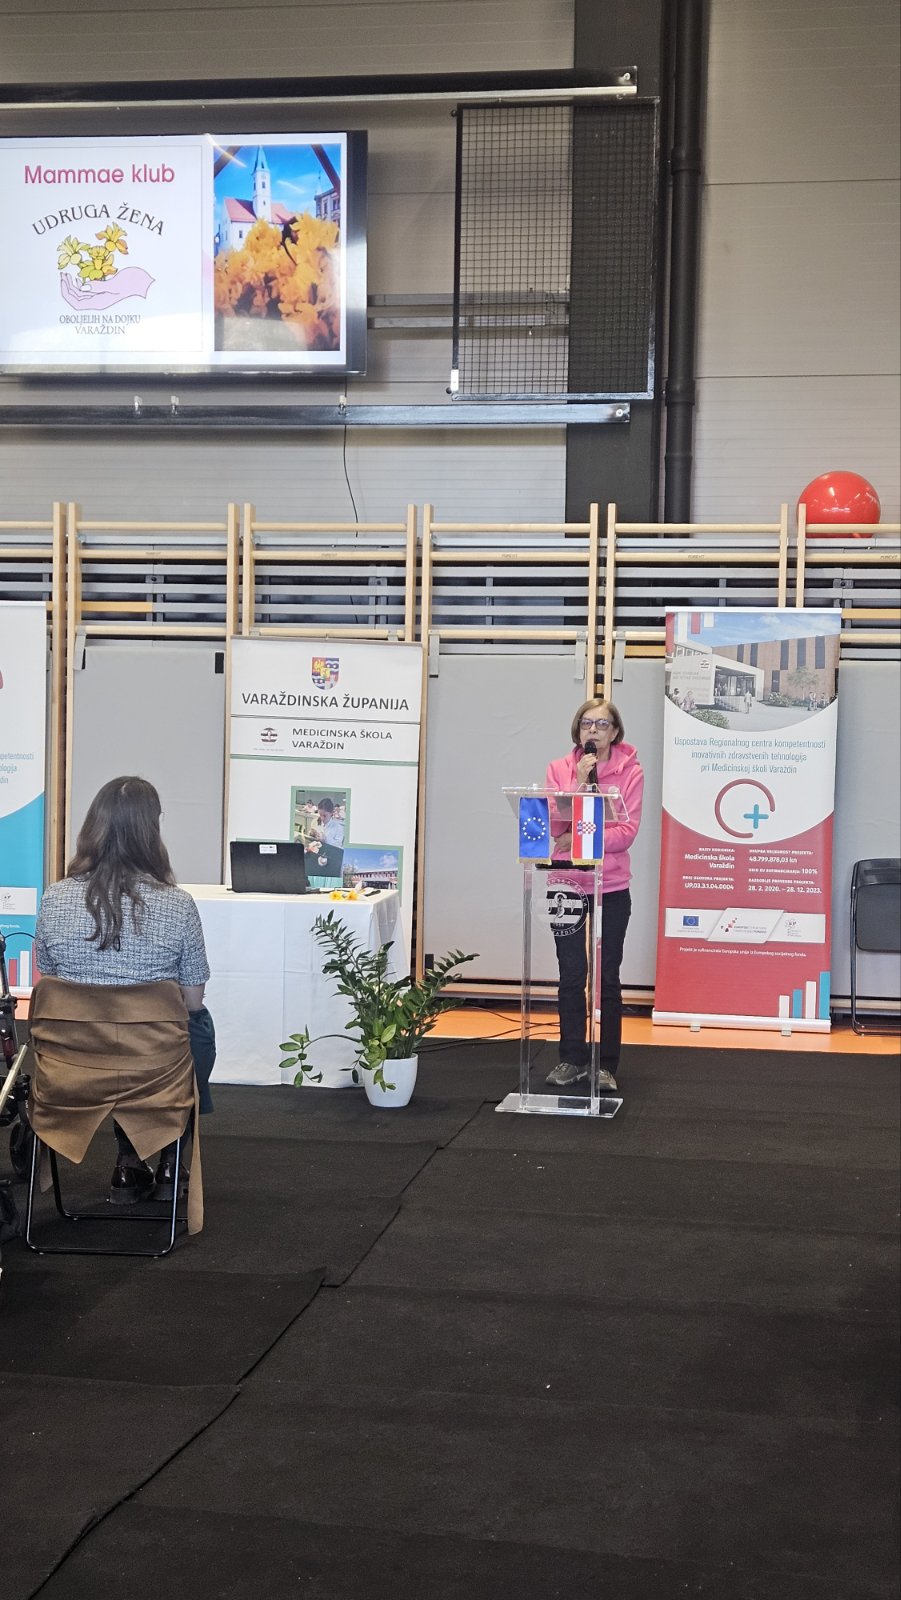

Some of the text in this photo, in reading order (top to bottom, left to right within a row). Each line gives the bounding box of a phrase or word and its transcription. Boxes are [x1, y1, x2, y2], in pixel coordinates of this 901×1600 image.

[24, 163, 175, 184] Mammae klub
[31, 201, 166, 236] UDRUGA ŽENA
[59, 314, 141, 325] OBOLJELIH NA DOJKU
[75, 324, 126, 335] VARAŽDIN
[241, 691, 409, 710] VARAŽDINSKA ŽUPANIJA
[292, 728, 393, 740] MEDICINSKA ŠKOLA
[292, 740, 345, 750] VARAŽDIN
[674, 736, 827, 750] Uspostava Regionalnog centra kompetentnosti
[691, 751, 807, 763] inovativnih zdravstvenih tehnologija
[701, 763, 710, 773] pri
[711, 763, 751, 774] Medicinskoj
[752, 763, 768, 773] školi
[684, 853, 735, 862] Medicinska škola
